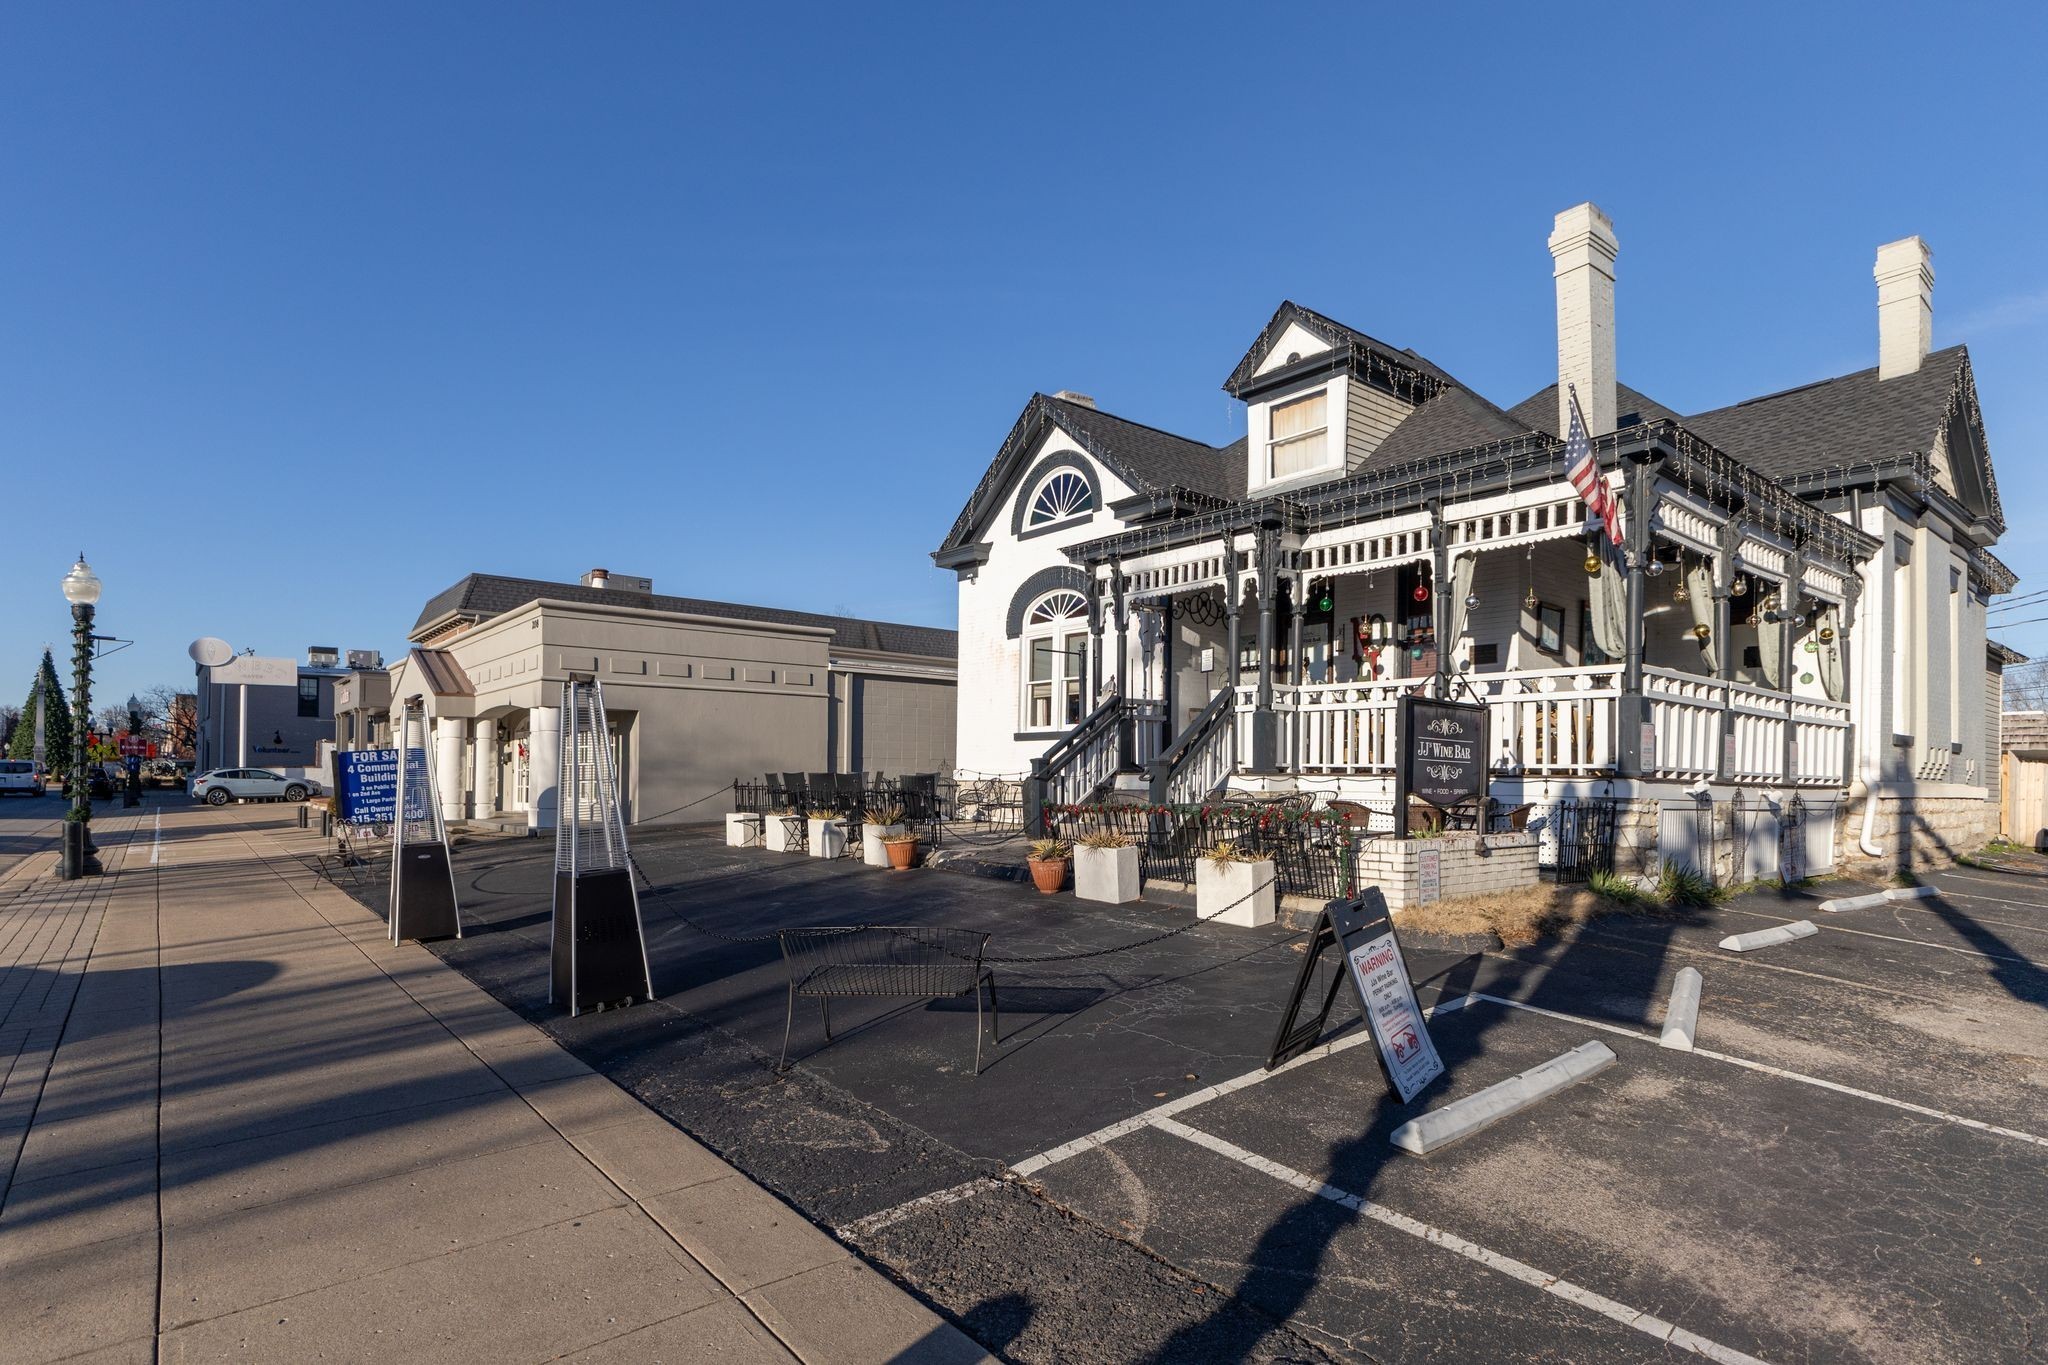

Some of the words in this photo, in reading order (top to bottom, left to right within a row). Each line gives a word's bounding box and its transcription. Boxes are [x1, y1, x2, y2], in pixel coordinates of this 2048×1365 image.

[253, 745, 290, 754] Volunteer
[352, 752, 378, 763] FOR
[381, 749, 412, 761] SAE
[1454, 744, 1471, 760] BAR
[347, 764, 355, 774] 4
[357, 760, 419, 773] Commeial
[360, 772, 408, 783] Buildin
[354, 806, 369, 815] Call
[1359, 948, 1394, 977] WARNING
[1377, 973, 1387, 983] Wine
[1386, 969, 1394, 978] Bar
[1383, 977, 1399, 989] PARKING
[1383, 991, 1392, 1001] ONLY
